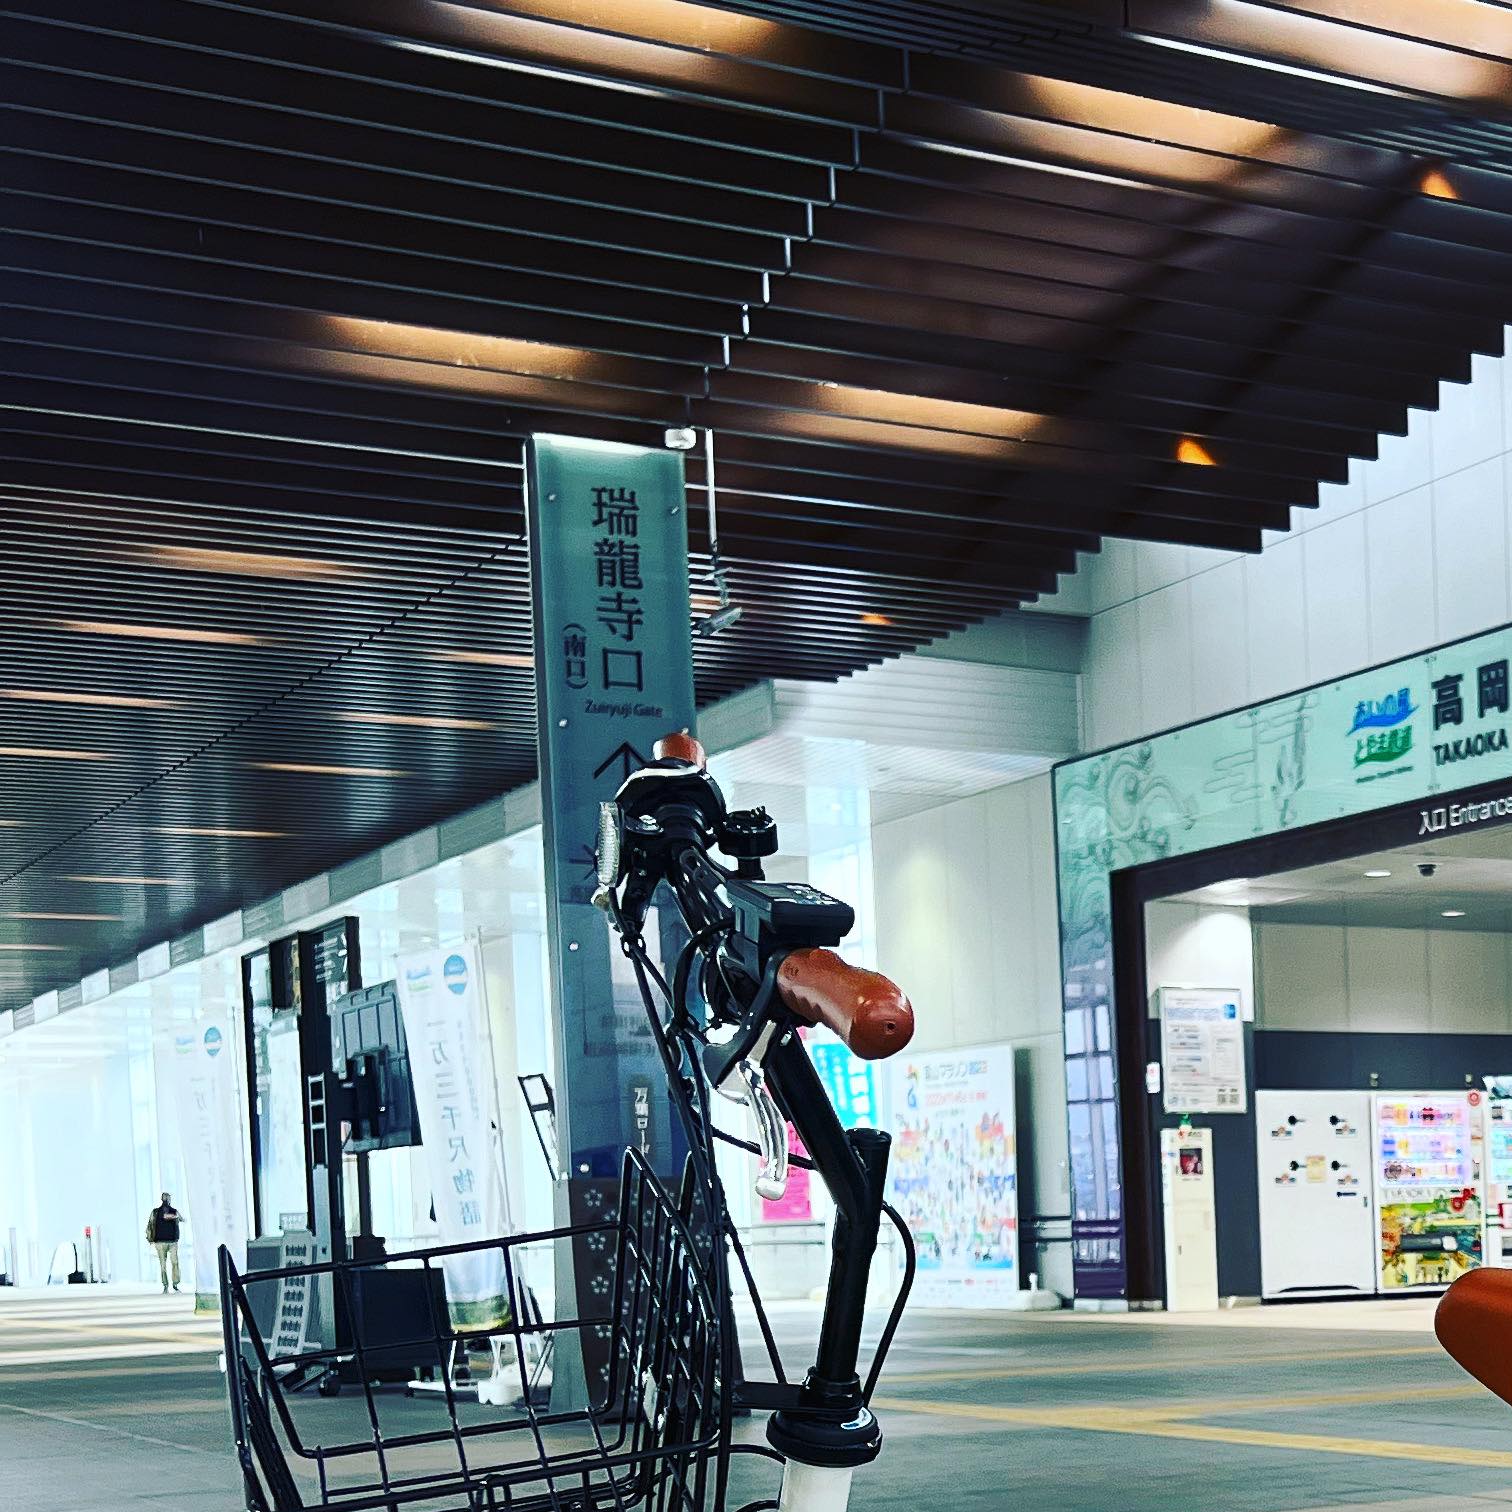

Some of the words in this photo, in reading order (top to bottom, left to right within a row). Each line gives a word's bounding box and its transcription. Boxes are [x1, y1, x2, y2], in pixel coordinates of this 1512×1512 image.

[590, 486, 644, 692] 瑞龍寺口
[1432, 728, 1509, 767] TAKAOKA
[1418, 808, 1447, 835] 入口
